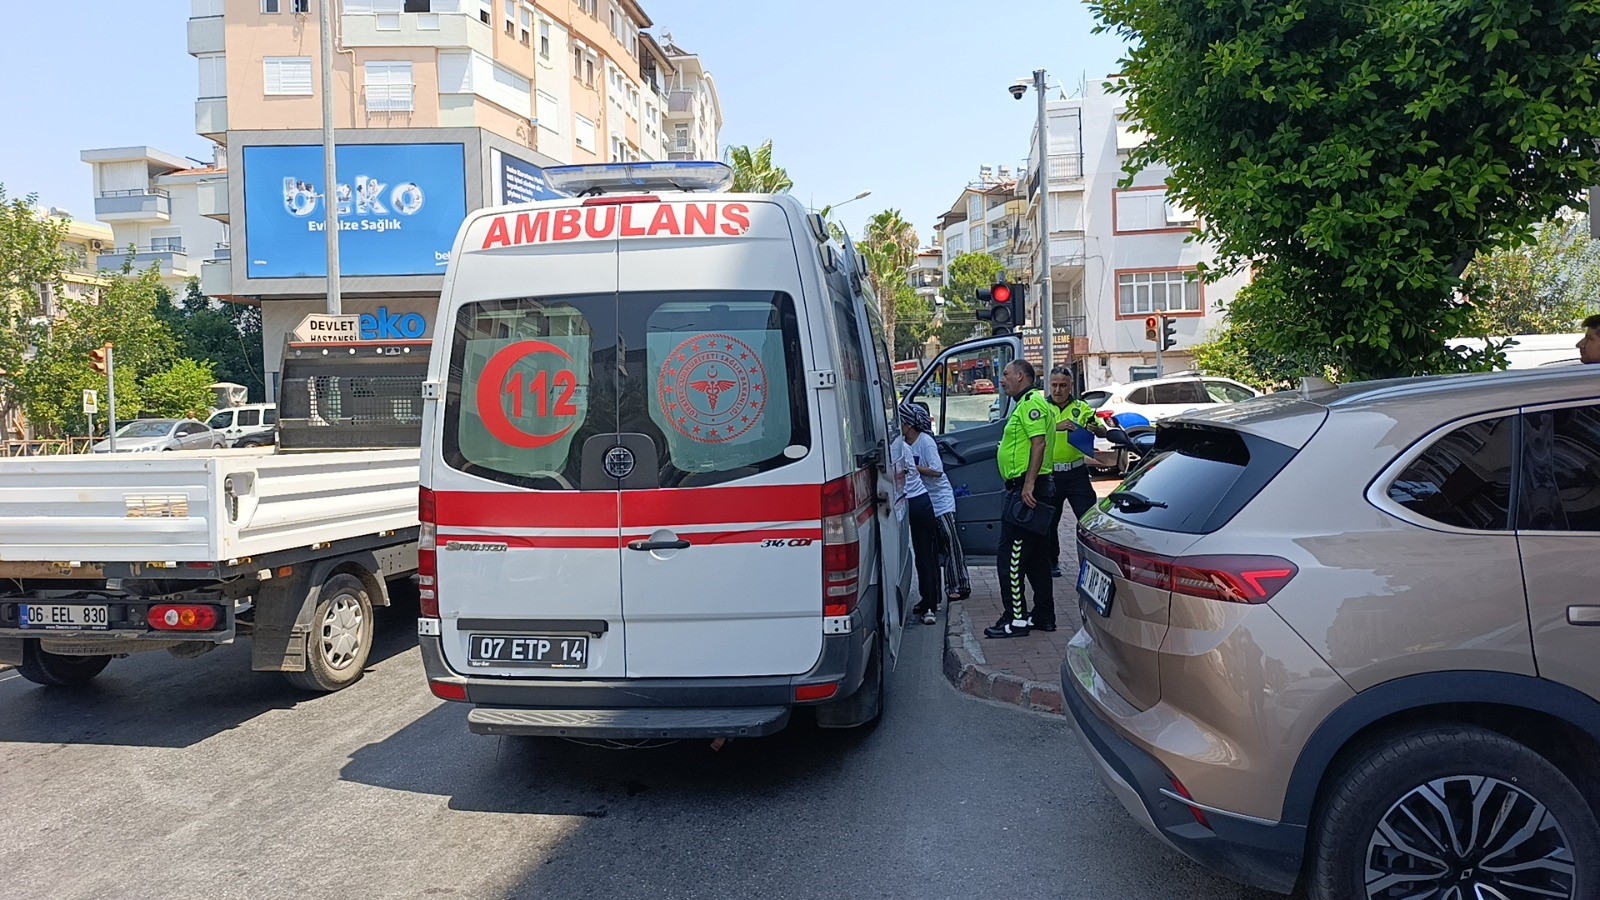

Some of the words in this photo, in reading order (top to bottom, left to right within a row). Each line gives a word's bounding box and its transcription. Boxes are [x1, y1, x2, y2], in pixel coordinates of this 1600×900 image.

[361, 218, 401, 232] Sağlık
[481, 203, 749, 249] AMBULANS
[310, 321, 354, 331] DEVLET
[361, 306, 427, 340] eko
[1023, 337, 1041, 345] OLTUK
[679, 353, 718, 388] CUMHURİYETİ
[720, 354, 744, 376] SAĞLIK
[505, 370, 577, 418] 112
[729, 376, 748, 416] BAKANLIĞI
[445, 541, 507, 552] SPRINTER
[760, 539, 785, 548] 316
[28, 607, 43, 622] 06
[52, 606, 75, 623] EEL
[83, 607, 106, 623] 830
[480, 638, 505, 659] 07
[511, 639, 551, 660] ETP
[560, 640, 582, 661] 14
